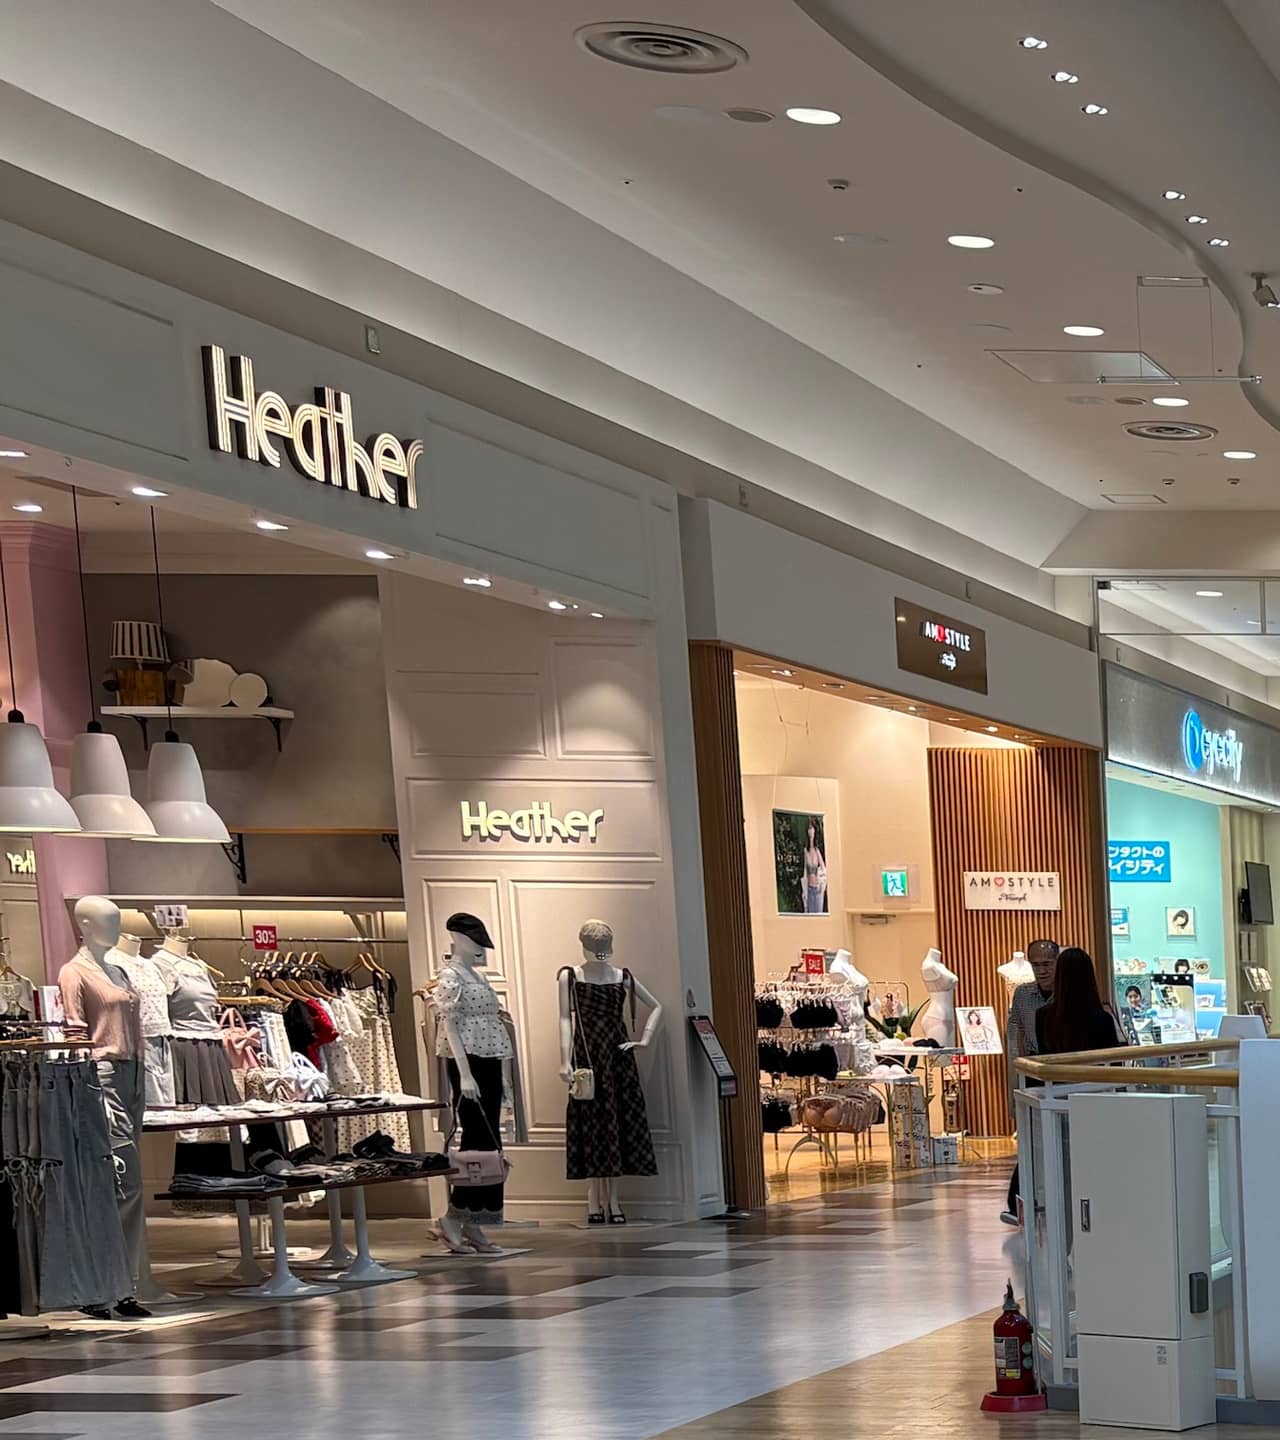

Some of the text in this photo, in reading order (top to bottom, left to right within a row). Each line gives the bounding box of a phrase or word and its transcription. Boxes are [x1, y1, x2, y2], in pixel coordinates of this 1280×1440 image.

[203, 345, 424, 509] Heather
[459, 800, 605, 843] Heather
[1108, 845, 1165, 858] ンタクトの
[1109, 859, 1165, 875] イシティ
